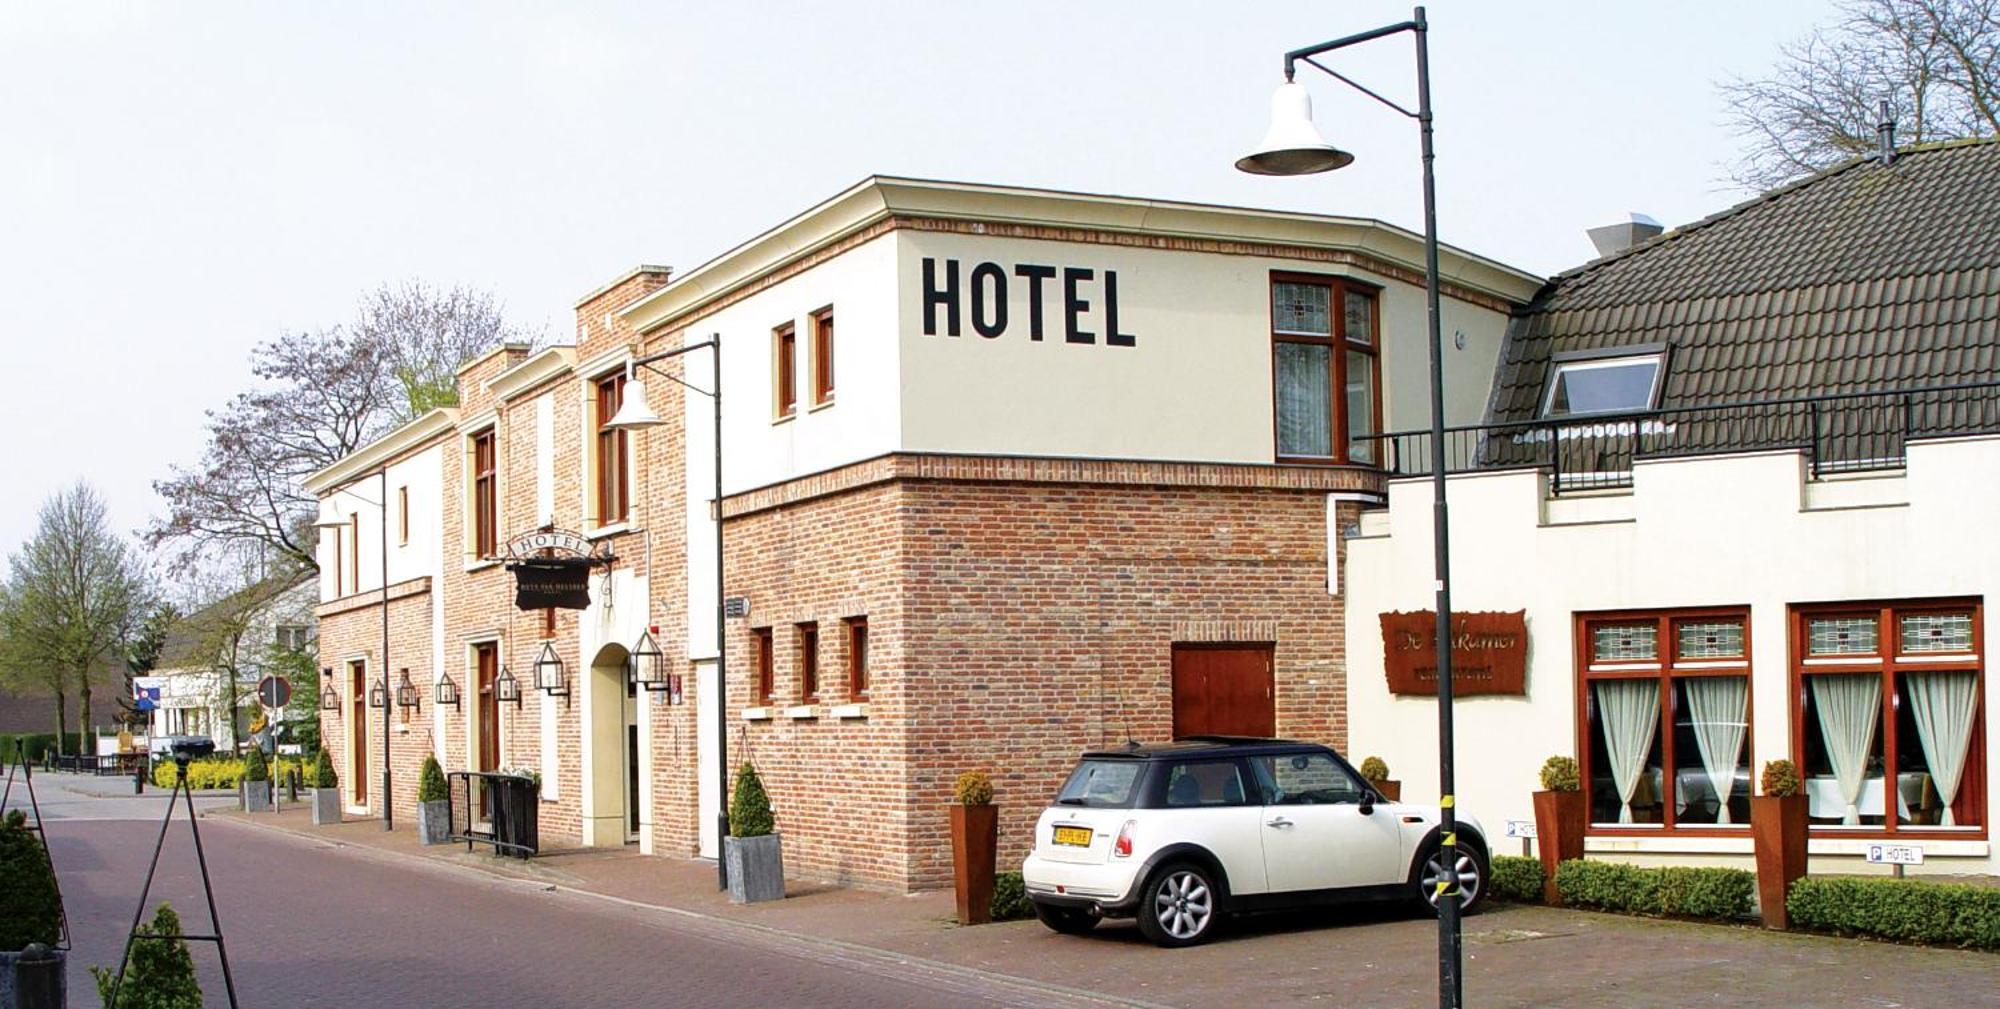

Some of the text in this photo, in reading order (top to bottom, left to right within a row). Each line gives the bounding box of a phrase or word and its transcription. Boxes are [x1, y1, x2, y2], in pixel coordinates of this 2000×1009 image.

[922, 257, 1136, 347] HOTEL
[520, 535, 584, 551] HOTEL
[1886, 847, 1916, 862] HOTEL
